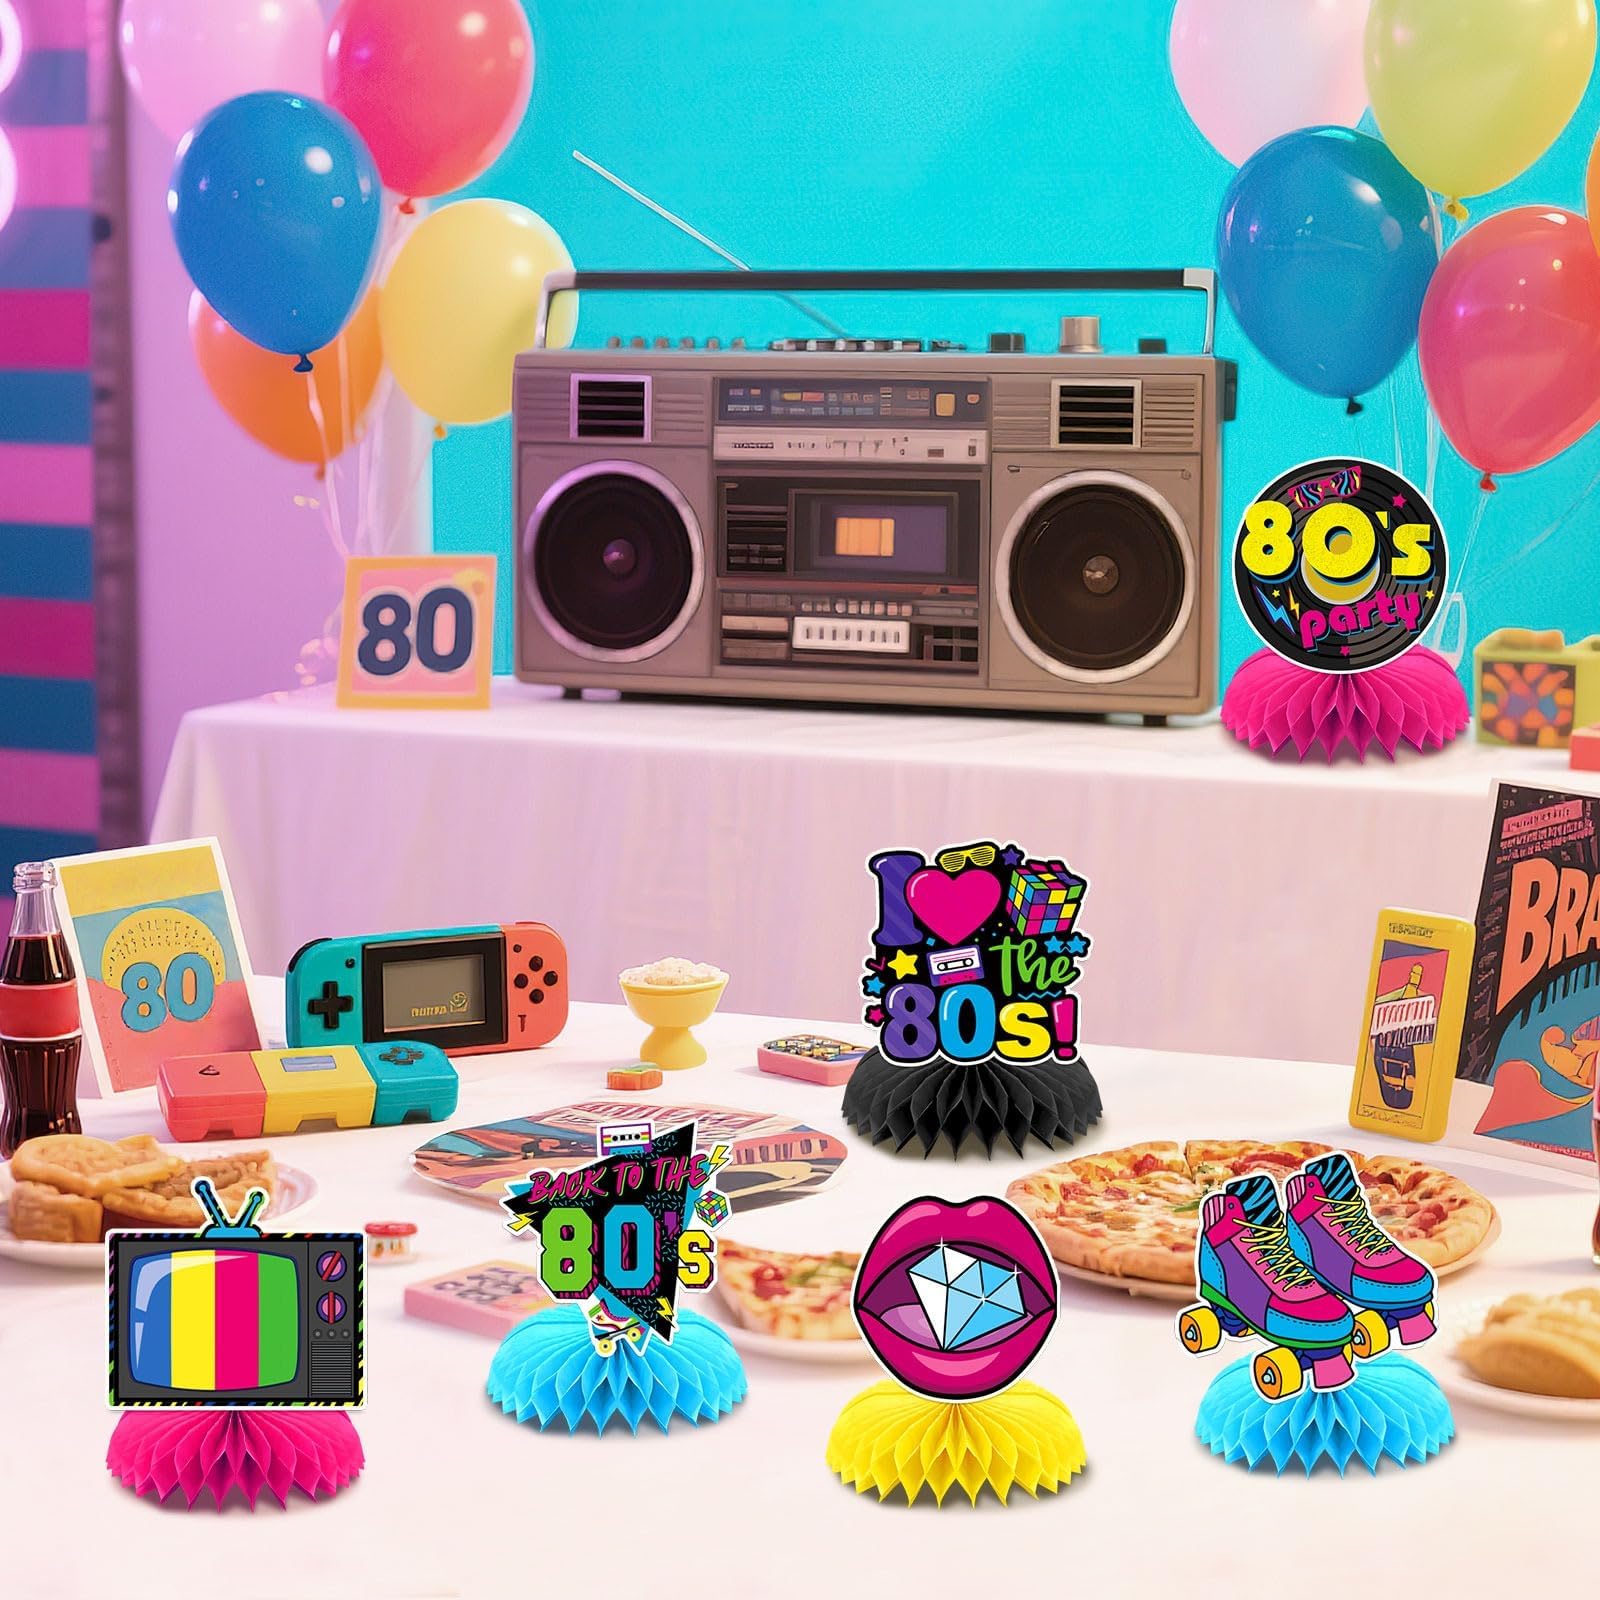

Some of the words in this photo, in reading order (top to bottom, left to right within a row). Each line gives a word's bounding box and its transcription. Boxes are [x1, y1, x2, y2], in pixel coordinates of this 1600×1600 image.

[1241, 500, 1434, 583] 80's
[358, 587, 473, 676] 80
[1300, 589, 1423, 651] party
[875, 854, 926, 946] I
[121, 952, 215, 1033] 80
[988, 935, 1077, 997] the
[884, 983, 1077, 1059] 80s!
[528, 1171, 607, 1204] BACK
[612, 1162, 643, 1196] TO
[653, 1153, 709, 1192] THE
[541, 1204, 714, 1299] 80's
